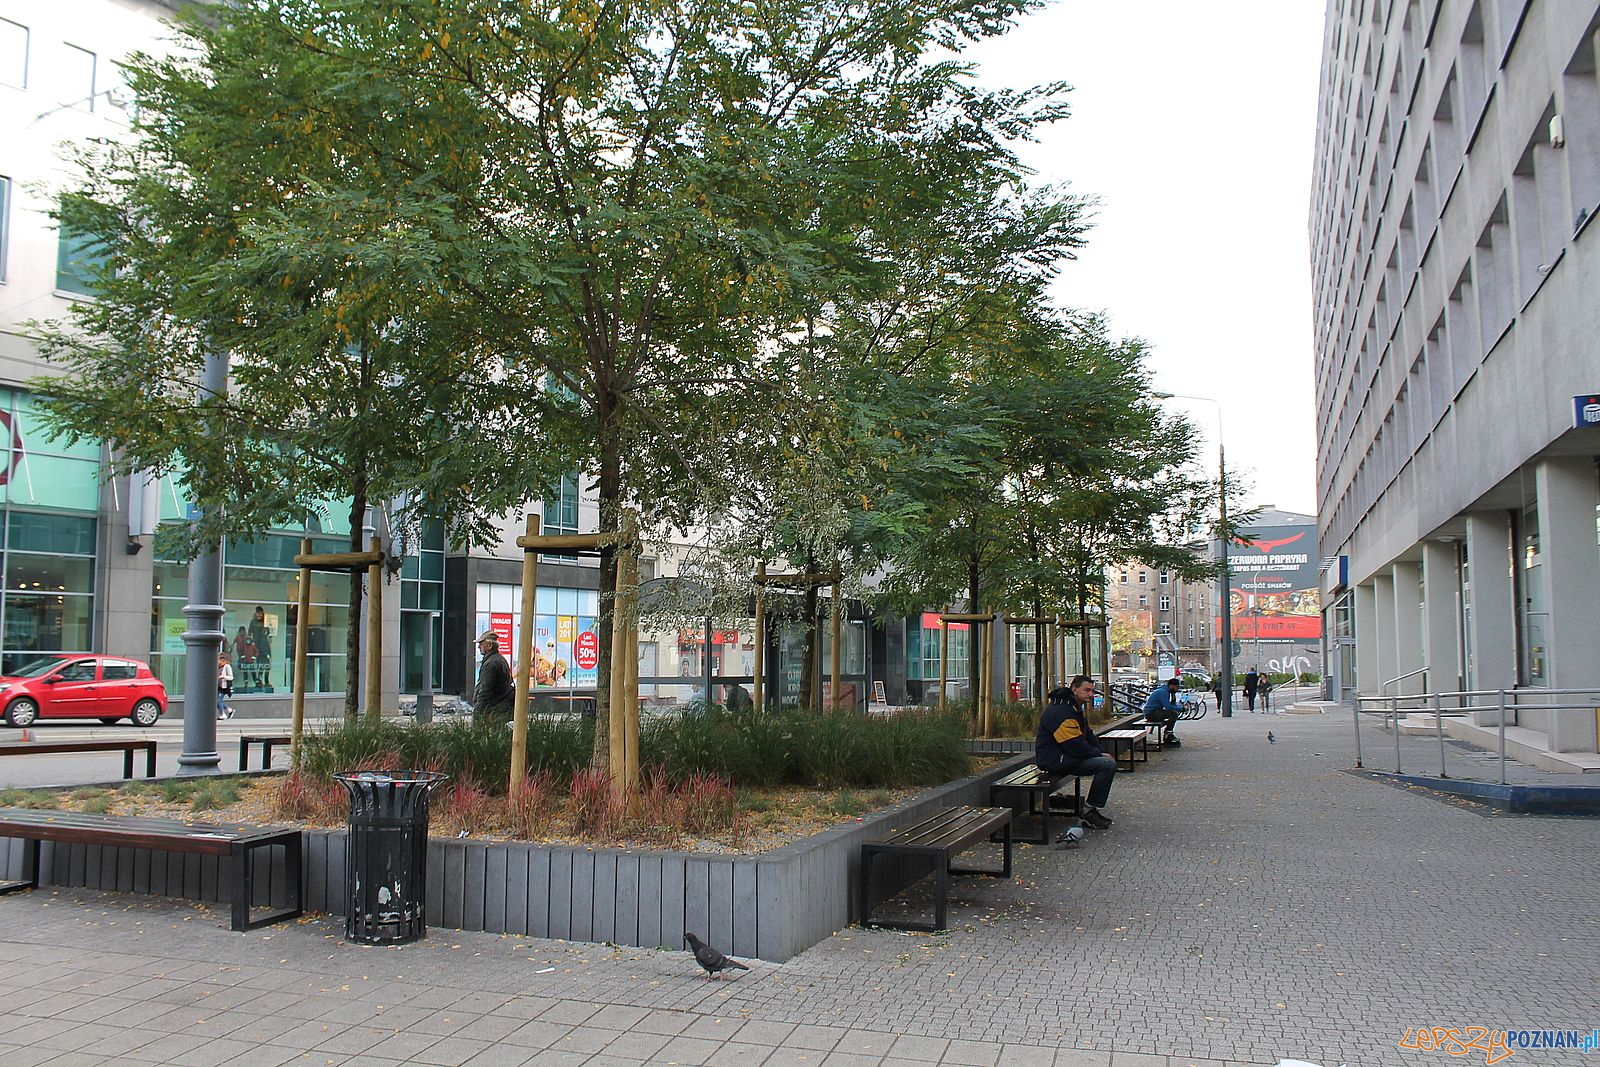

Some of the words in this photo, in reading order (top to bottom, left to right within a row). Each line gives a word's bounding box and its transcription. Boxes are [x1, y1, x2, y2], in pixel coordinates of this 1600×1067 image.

[1269, 554, 1308, 564] PAPRYKA
[537, 628, 549, 636] TUI
[579, 648, 596, 658] 50%
